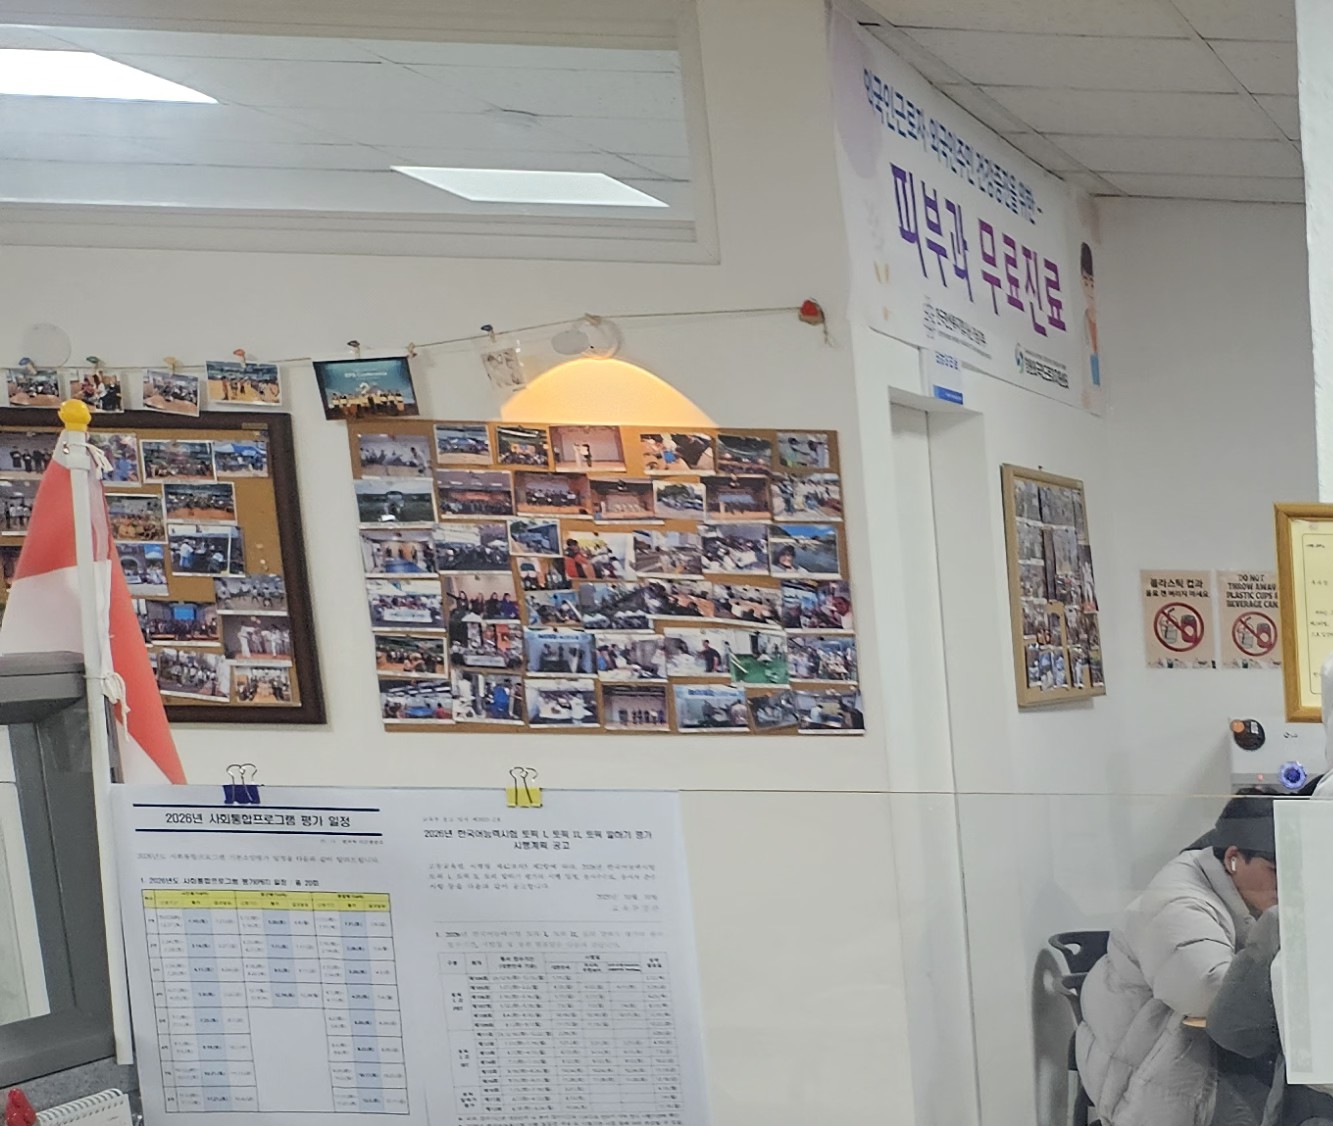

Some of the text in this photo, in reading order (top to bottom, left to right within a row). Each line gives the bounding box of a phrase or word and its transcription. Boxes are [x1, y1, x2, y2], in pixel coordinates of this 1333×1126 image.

[864, 68, 926, 152] 외국인근로자
[889, 161, 974, 304] 피부과
[977, 217, 1067, 338] 무료진료
[1238, 574, 1265, 582] DO NOT
[1150, 578, 1203, 588] 플라스틱 컵과
[1228, 582, 1253, 590] THROW
[1227, 591, 1273, 600] PLASTIC CUPS
[1227, 600, 1262, 608] BEVERAGE
[165, 812, 351, 828] 2026년 사회통합프로그램 평가 일정
[424, 829, 453, 839] 2026년
[457, 829, 518, 839] 한국어능력시험
[514, 841, 571, 850] 시행계획 공고
